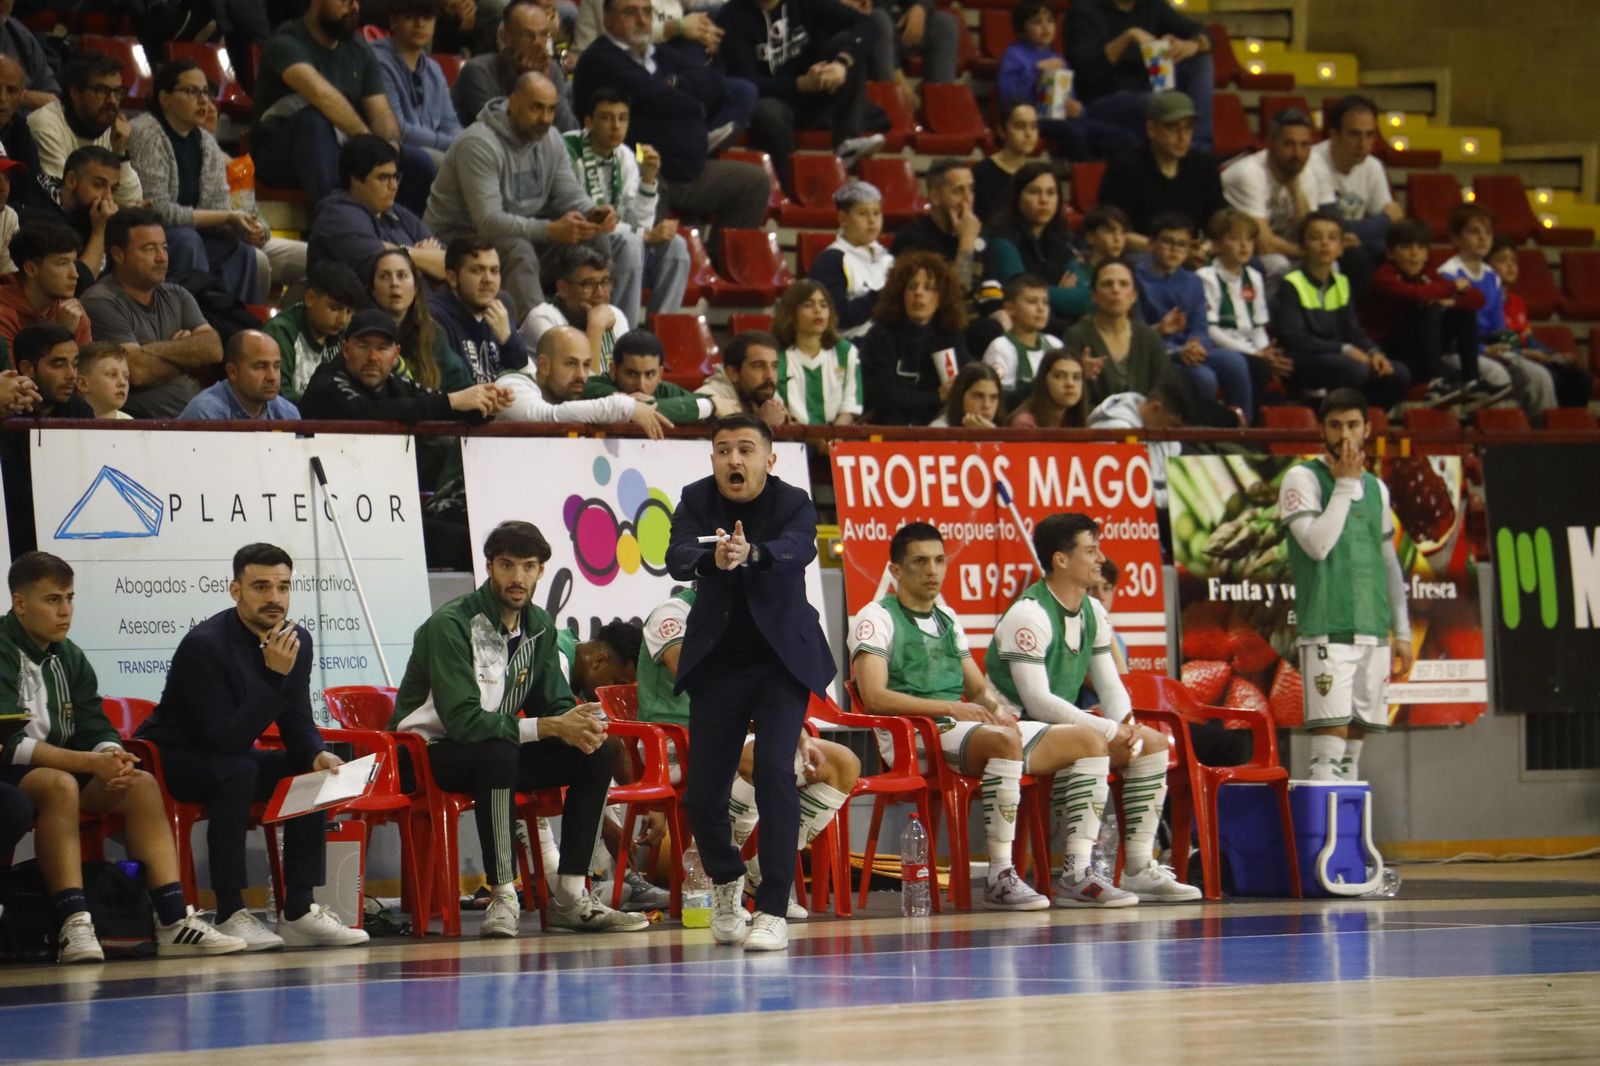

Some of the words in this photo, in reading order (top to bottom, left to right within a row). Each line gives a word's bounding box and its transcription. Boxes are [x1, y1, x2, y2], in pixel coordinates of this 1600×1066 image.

[836, 454, 1014, 509] TROFEOS
[1028, 454, 1154, 509] MAGO
[168, 493, 406, 523] PLATECOR
[843, 516, 893, 541] Avda.
[115, 576, 187, 598] Abogados
[289, 574, 357, 592] inistrativos
[985, 562, 1034, 598] 957
[1207, 576, 1263, 602] Fruta
[1264, 580, 1279, 608] y
[1412, 573, 1457, 600] fresca
[118, 618, 177, 634] Asesores
[297, 614, 316, 632] de
[319, 613, 361, 632] Fincas
[319, 655, 368, 670] SERVICIO
